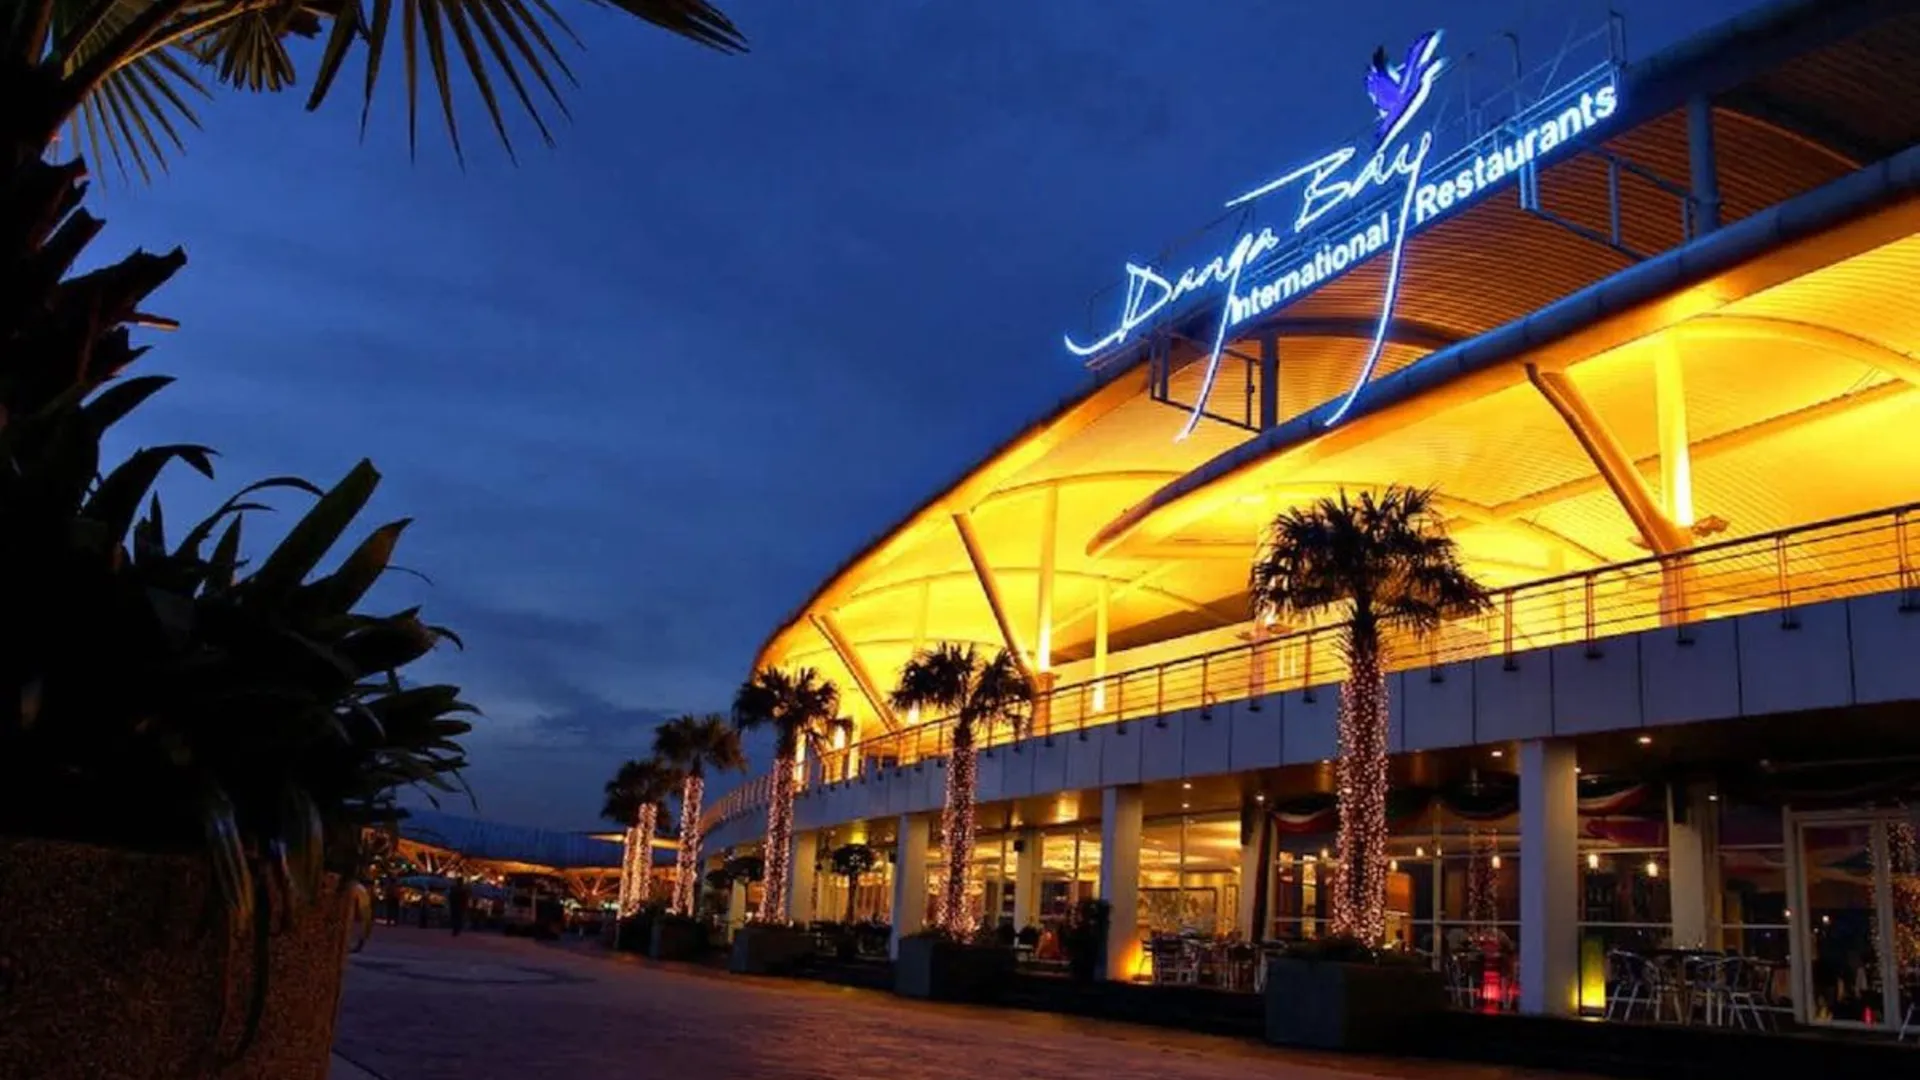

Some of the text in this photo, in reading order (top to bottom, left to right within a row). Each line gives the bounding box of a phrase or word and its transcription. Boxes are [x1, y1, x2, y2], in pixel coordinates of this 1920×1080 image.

[1064, 131, 1432, 443] Danga Bay
[1230, 84, 1618, 326] International Restaurants
